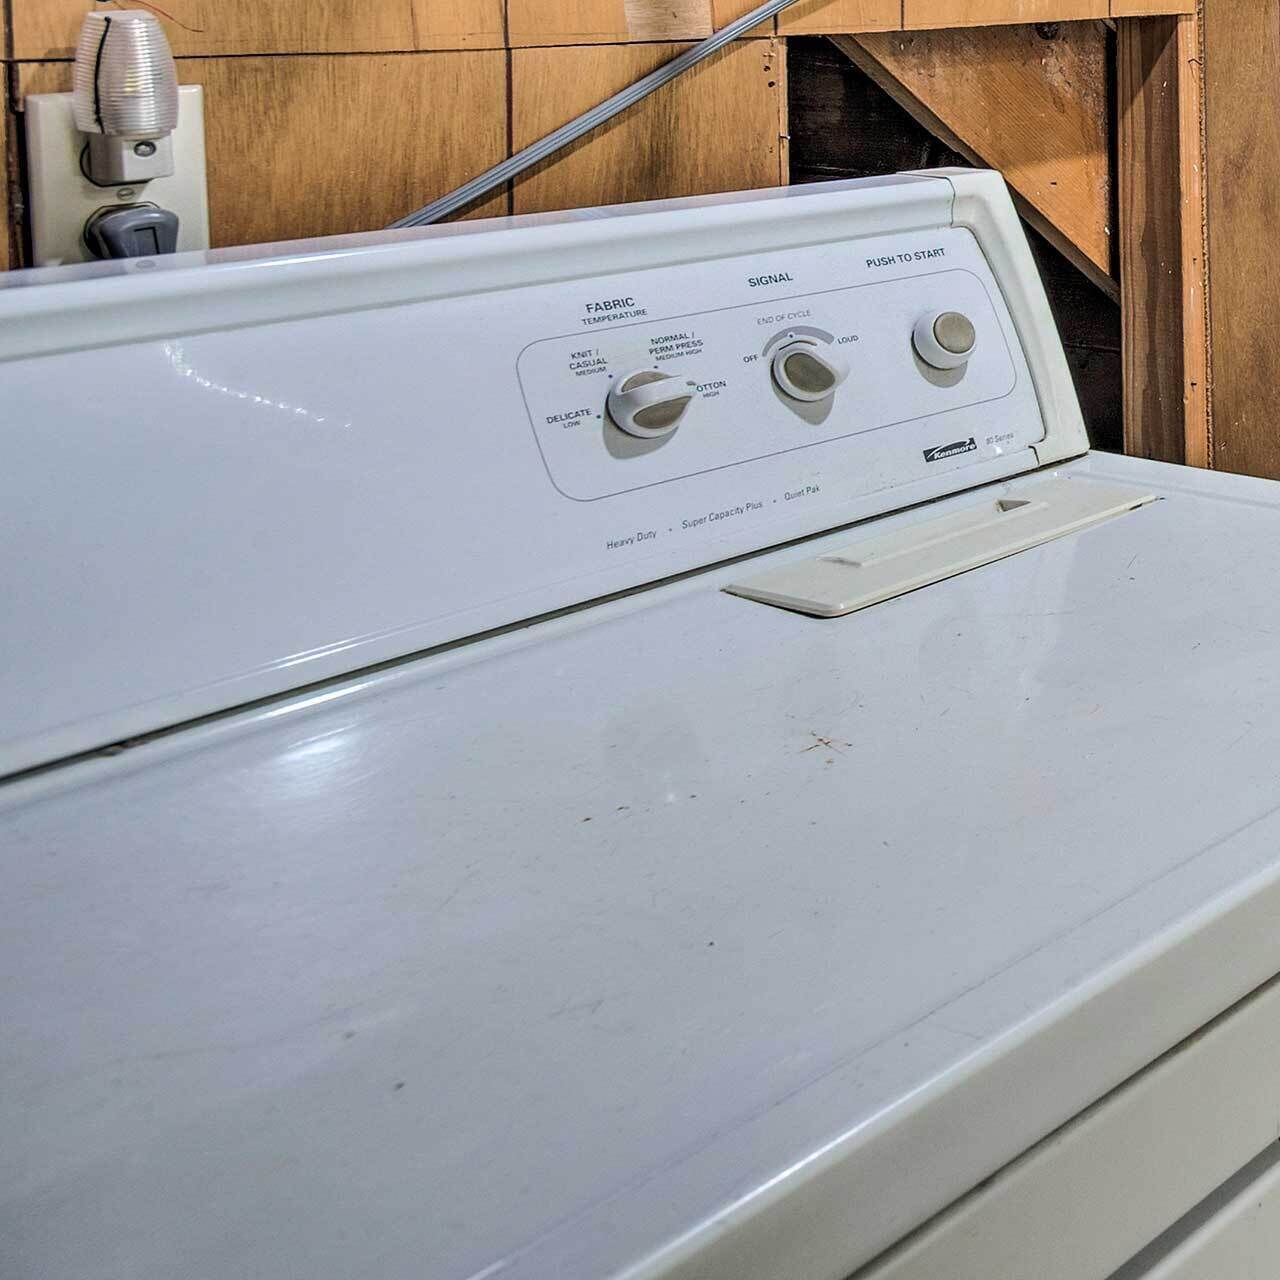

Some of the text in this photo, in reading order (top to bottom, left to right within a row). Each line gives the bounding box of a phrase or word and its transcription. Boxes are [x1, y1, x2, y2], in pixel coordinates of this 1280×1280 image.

[866, 248, 946, 268] PUSH TO START
[748, 272, 794, 287] SIGNAL
[585, 297, 636, 314] FABRIC
[582, 308, 648, 326] TEMPERATURE
[757, 309, 813, 326] END OF CYCLE
[651, 332, 690, 346] NORMAL
[837, 335, 859, 345] LOUD
[649, 339, 704, 355] PERM PRESS
[571, 349, 593, 360] KNIT
[655, 351, 684, 361] MEDIUM
[743, 355, 759, 364] OFF
[569, 358, 608, 371] CASUAL
[575, 366, 607, 377] MEDIUM
[696, 380, 727, 393] OTTON
[546, 408, 593, 424] DELICATE
[563, 420, 581, 429] LOW
[933, 443, 976, 460] Kenmore
[607, 484, 820, 550] Heavy Duty Super Capacity Plus Quiet Pak
